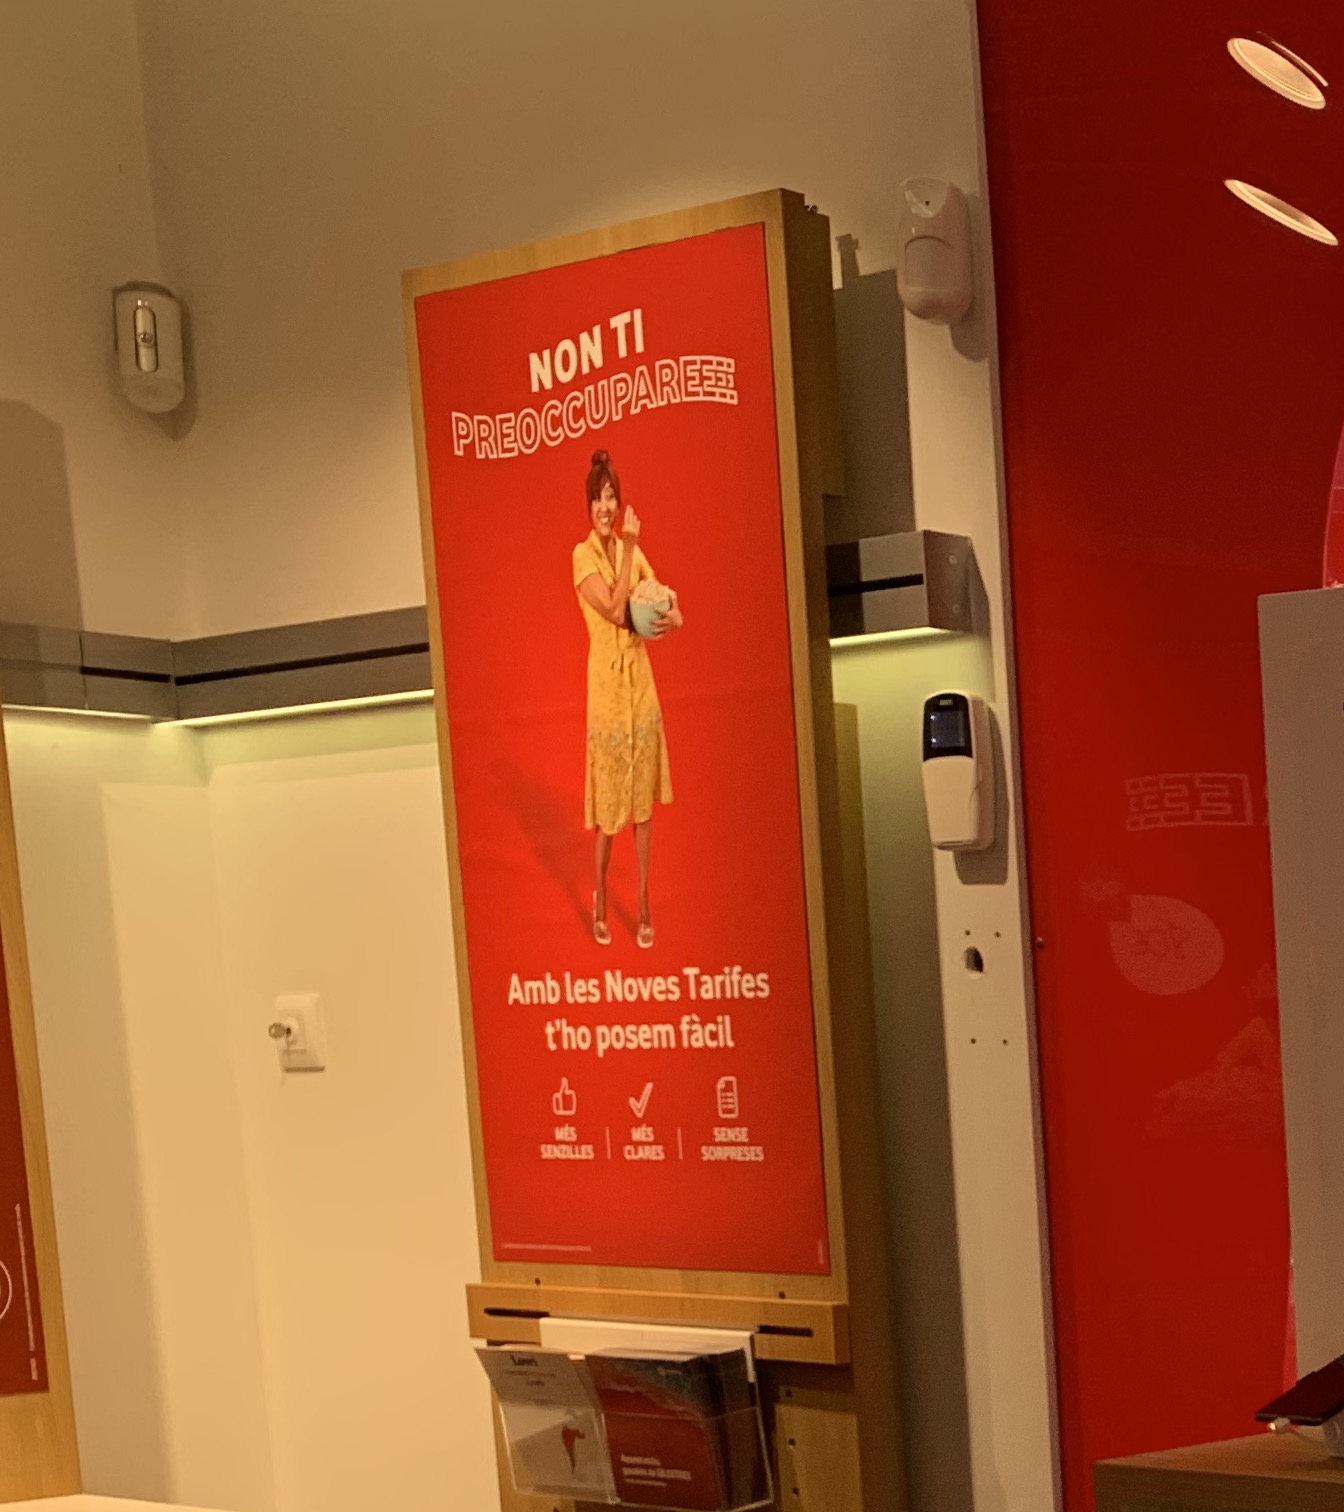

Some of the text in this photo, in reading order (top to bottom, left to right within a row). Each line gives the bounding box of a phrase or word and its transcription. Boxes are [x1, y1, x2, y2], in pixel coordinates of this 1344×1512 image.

[529, 308, 645, 393] NON TI
[508, 965, 771, 1006] Amb les Noves Tarifes
[545, 1014, 735, 1058] t'ho posem fàcil
[624, 1145, 665, 1160] CLARES
